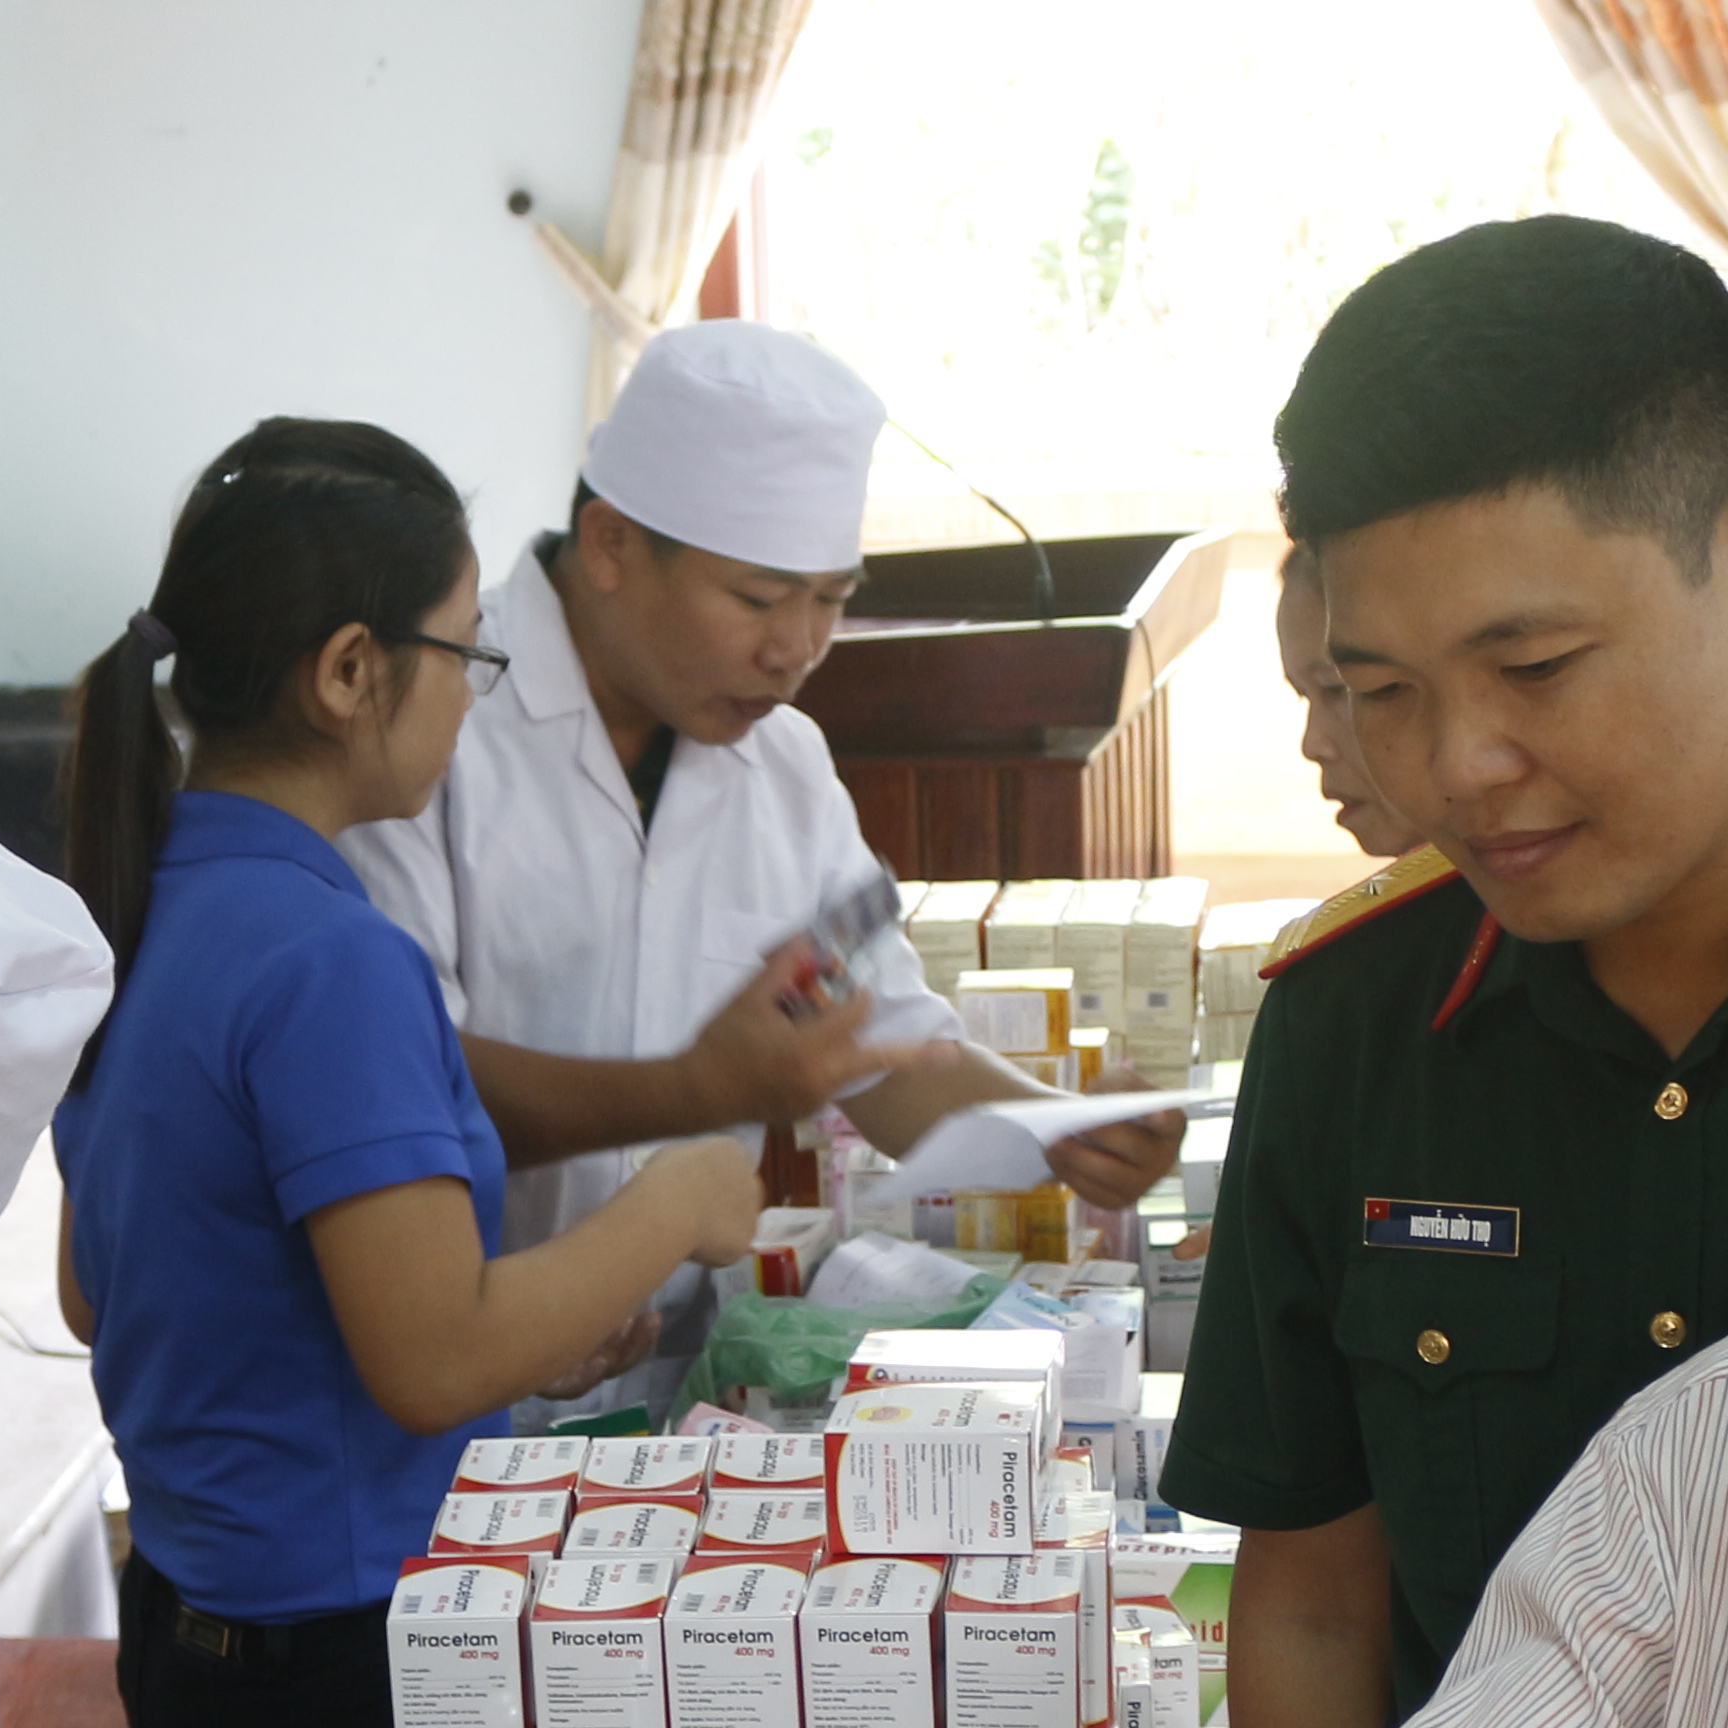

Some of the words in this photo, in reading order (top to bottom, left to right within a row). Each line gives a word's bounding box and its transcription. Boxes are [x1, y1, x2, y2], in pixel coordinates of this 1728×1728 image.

[1002, 1451, 1018, 1539] Piracetam
[990, 1500, 1001, 1521] 400
[407, 1633, 498, 1648] Piracetam
[551, 1630, 643, 1646] Piracetam
[682, 1629, 774, 1643] Piracetam
[817, 1627, 909, 1642] Piracetam
[964, 1626, 1057, 1642] Piracetam
[459, 1650, 479, 1659] 400
[482, 1651, 500, 1660] mg
[604, 1649, 624, 1658] 400
[626, 1650, 644, 1659] mg
[734, 1647, 754, 1656] 400
[756, 1647, 775, 1657] mg
[869, 1646, 889, 1655] 400
[891, 1646, 910, 1657] mg
[1015, 1645, 1036, 1655] 400
[1037, 1646, 1057, 1657] mg
